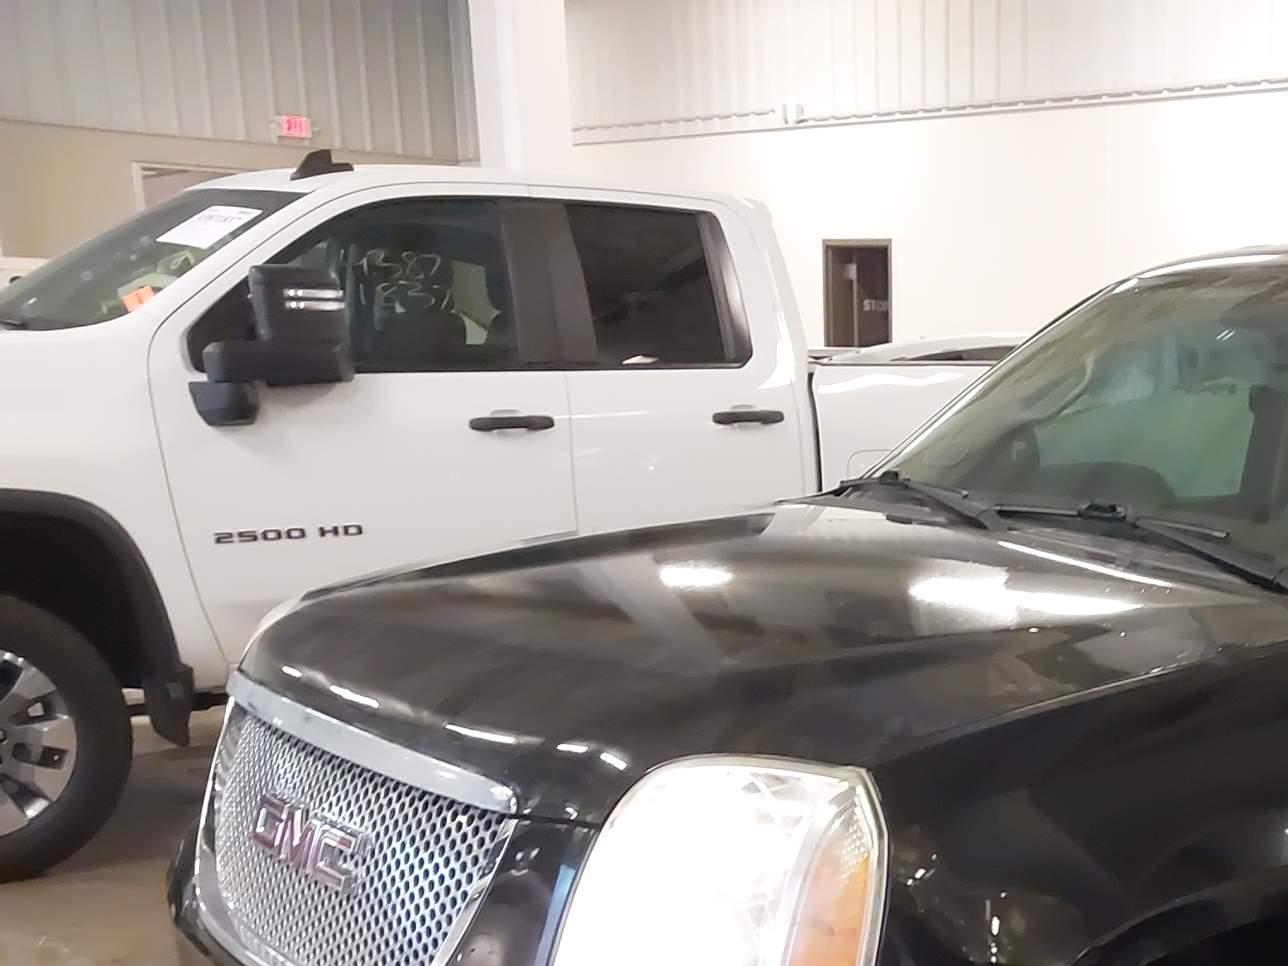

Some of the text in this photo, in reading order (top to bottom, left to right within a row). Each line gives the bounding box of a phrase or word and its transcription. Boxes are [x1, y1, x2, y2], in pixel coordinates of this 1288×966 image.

[213, 524, 363, 544] 2500 HD
[250, 793, 357, 894] GMC
